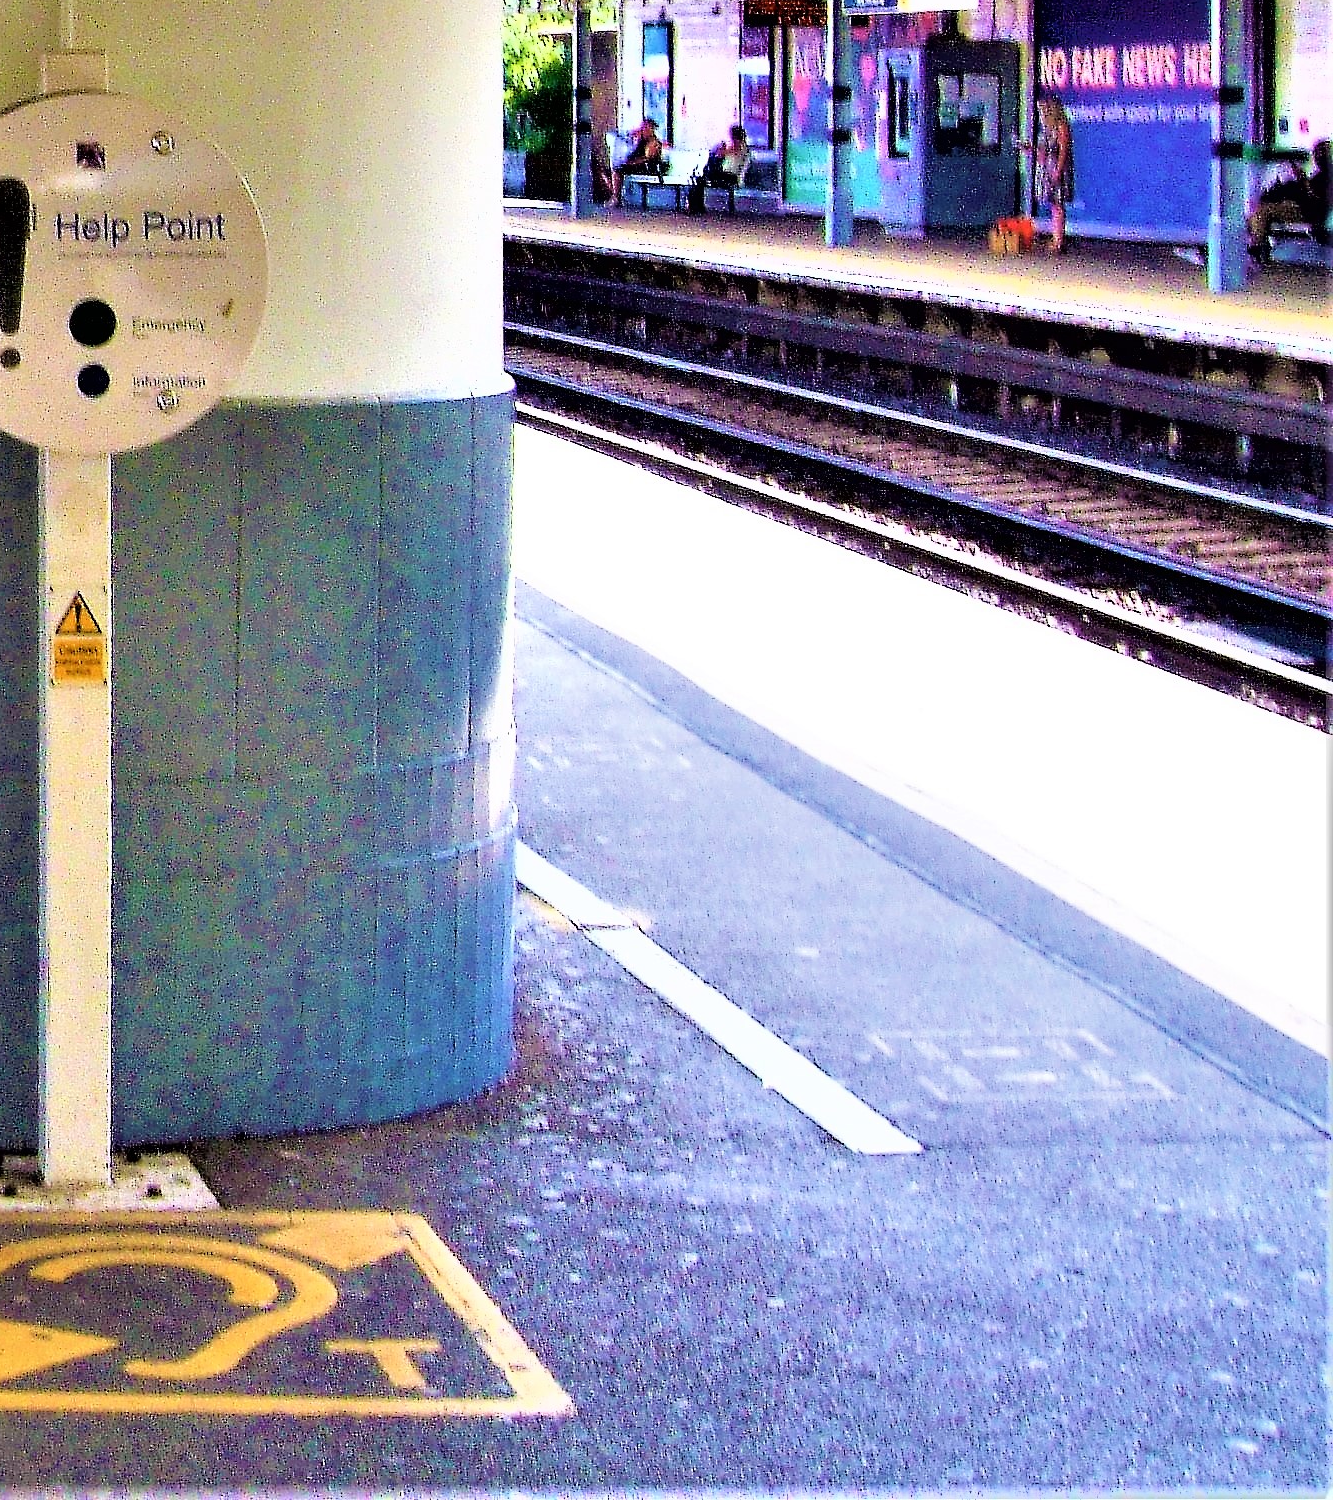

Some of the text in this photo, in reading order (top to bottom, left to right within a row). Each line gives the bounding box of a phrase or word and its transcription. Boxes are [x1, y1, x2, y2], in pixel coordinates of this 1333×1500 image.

[1039, 48, 1066, 89] NO
[1072, 47, 1117, 88] FAKE
[1122, 44, 1179, 88] NEWS
[55, 211, 226, 248] Help Point
